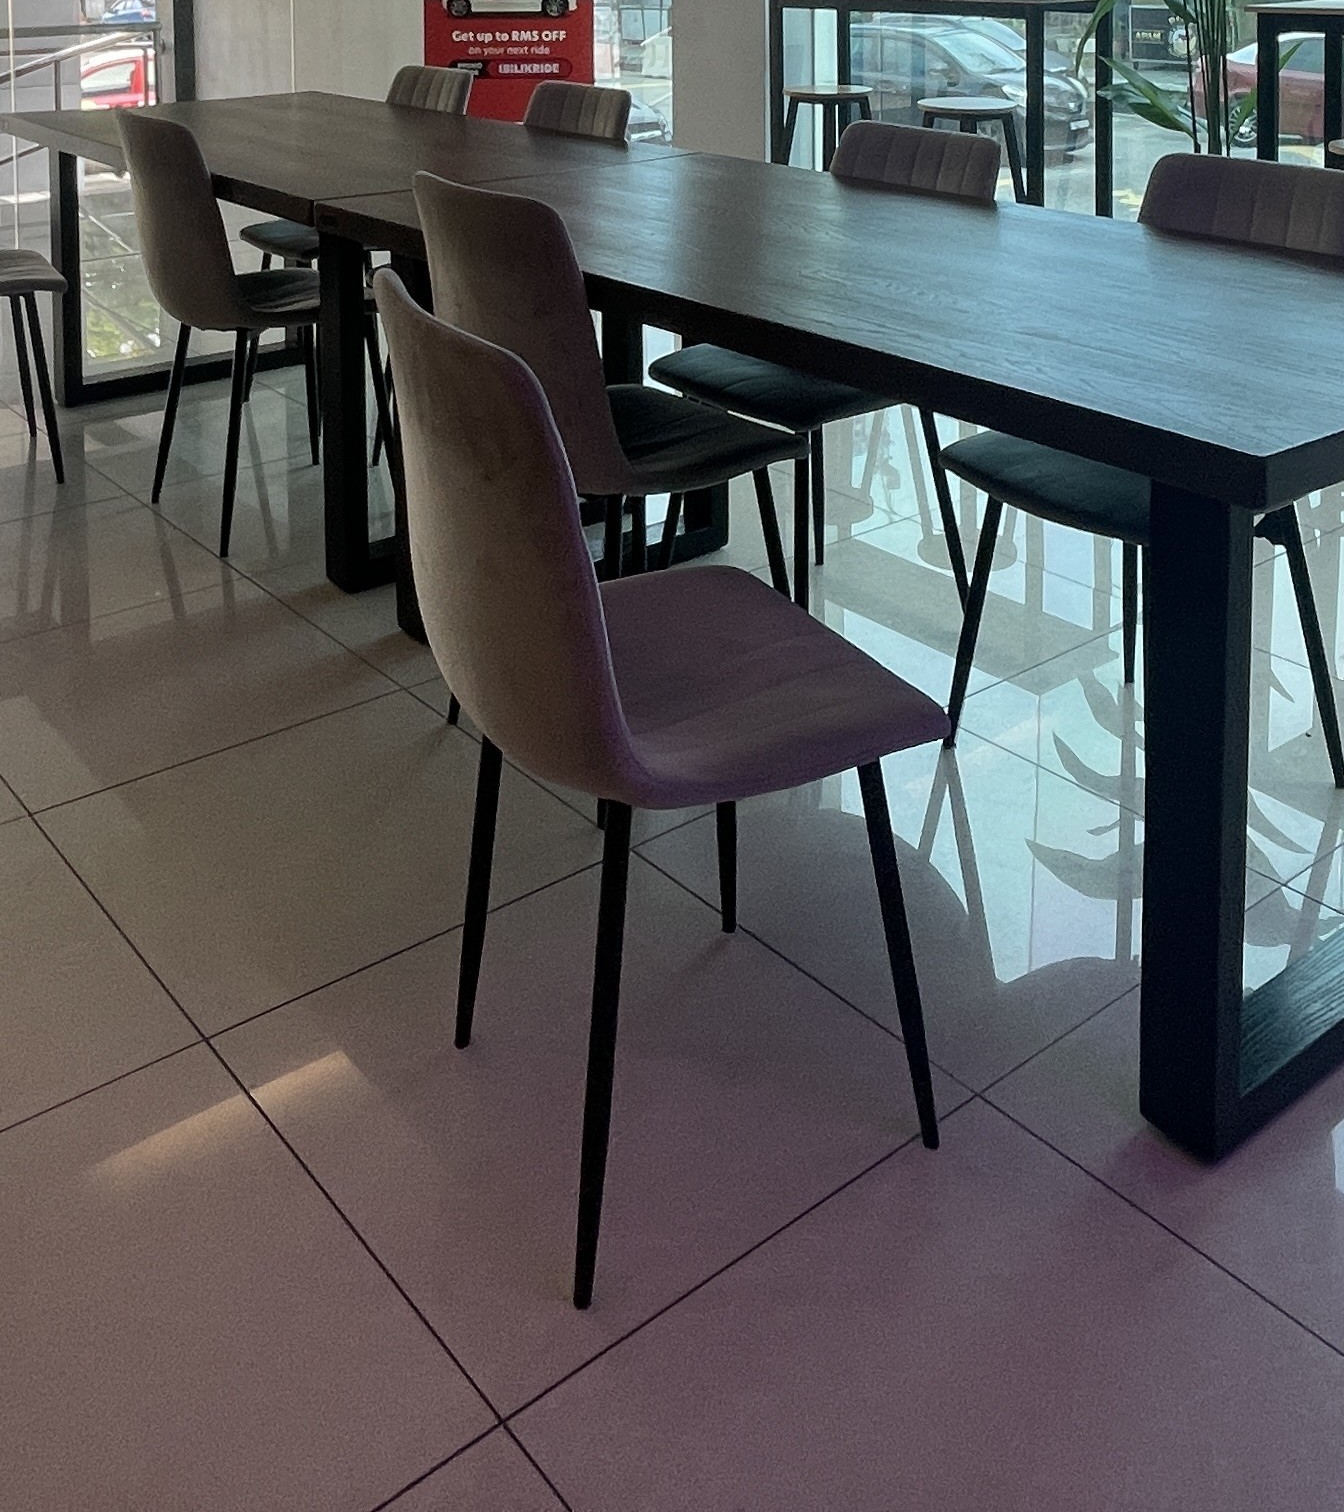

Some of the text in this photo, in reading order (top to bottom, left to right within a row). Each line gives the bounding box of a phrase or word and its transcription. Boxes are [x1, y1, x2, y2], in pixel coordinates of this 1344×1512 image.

[452, 31, 474, 42] Get
[476, 32, 493, 44] up
[495, 32, 510, 42] to
[541, 30, 567, 41] OFF
[468, 44, 551, 56] on your next ride
